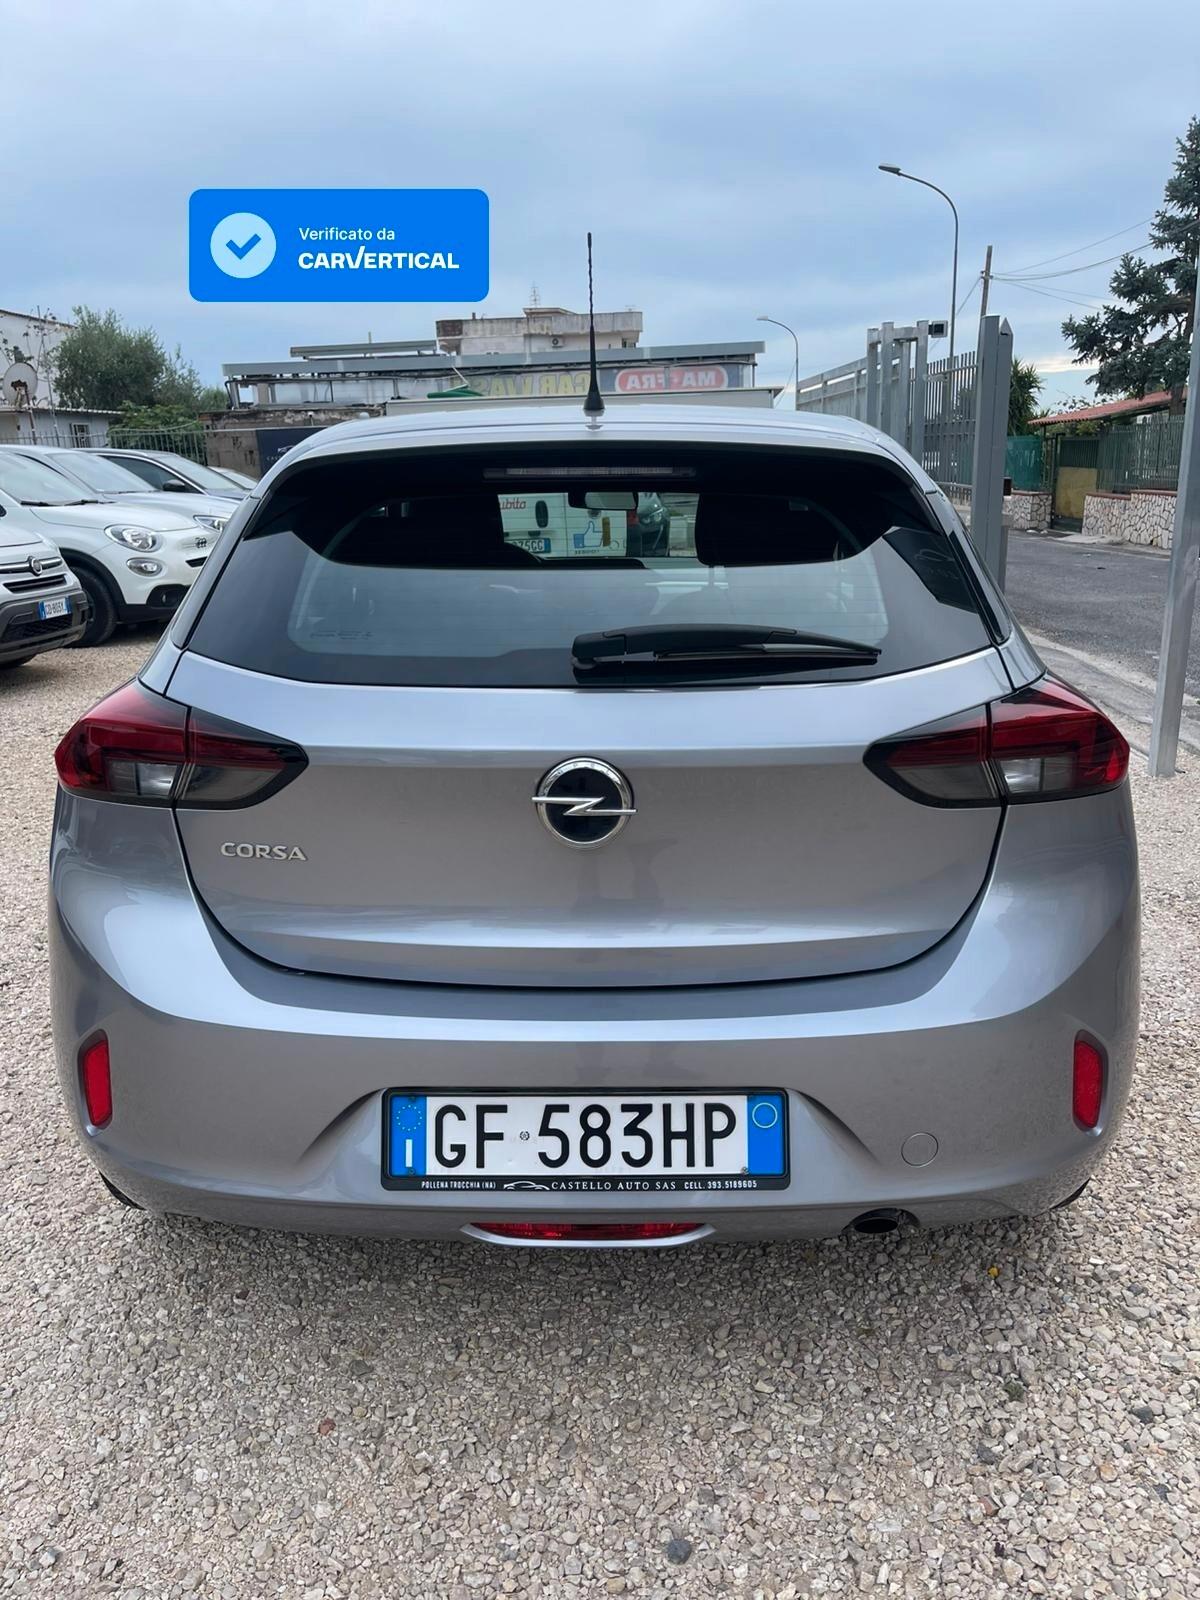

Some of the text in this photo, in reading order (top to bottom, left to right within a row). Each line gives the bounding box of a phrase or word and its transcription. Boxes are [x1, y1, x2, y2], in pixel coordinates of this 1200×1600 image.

[220, 842, 307, 861] CORSA
[434, 1103, 737, 1169] GF 583HP
[421, 1181, 496, 1190] POLLENA TROCCHIA (NA)
[551, 1181, 612, 1190] CASTELLO
[617, 1181, 650, 1190] AUTO
[655, 1181, 676, 1190] SAS
[707, 1180, 757, 1189] 393.5189605
